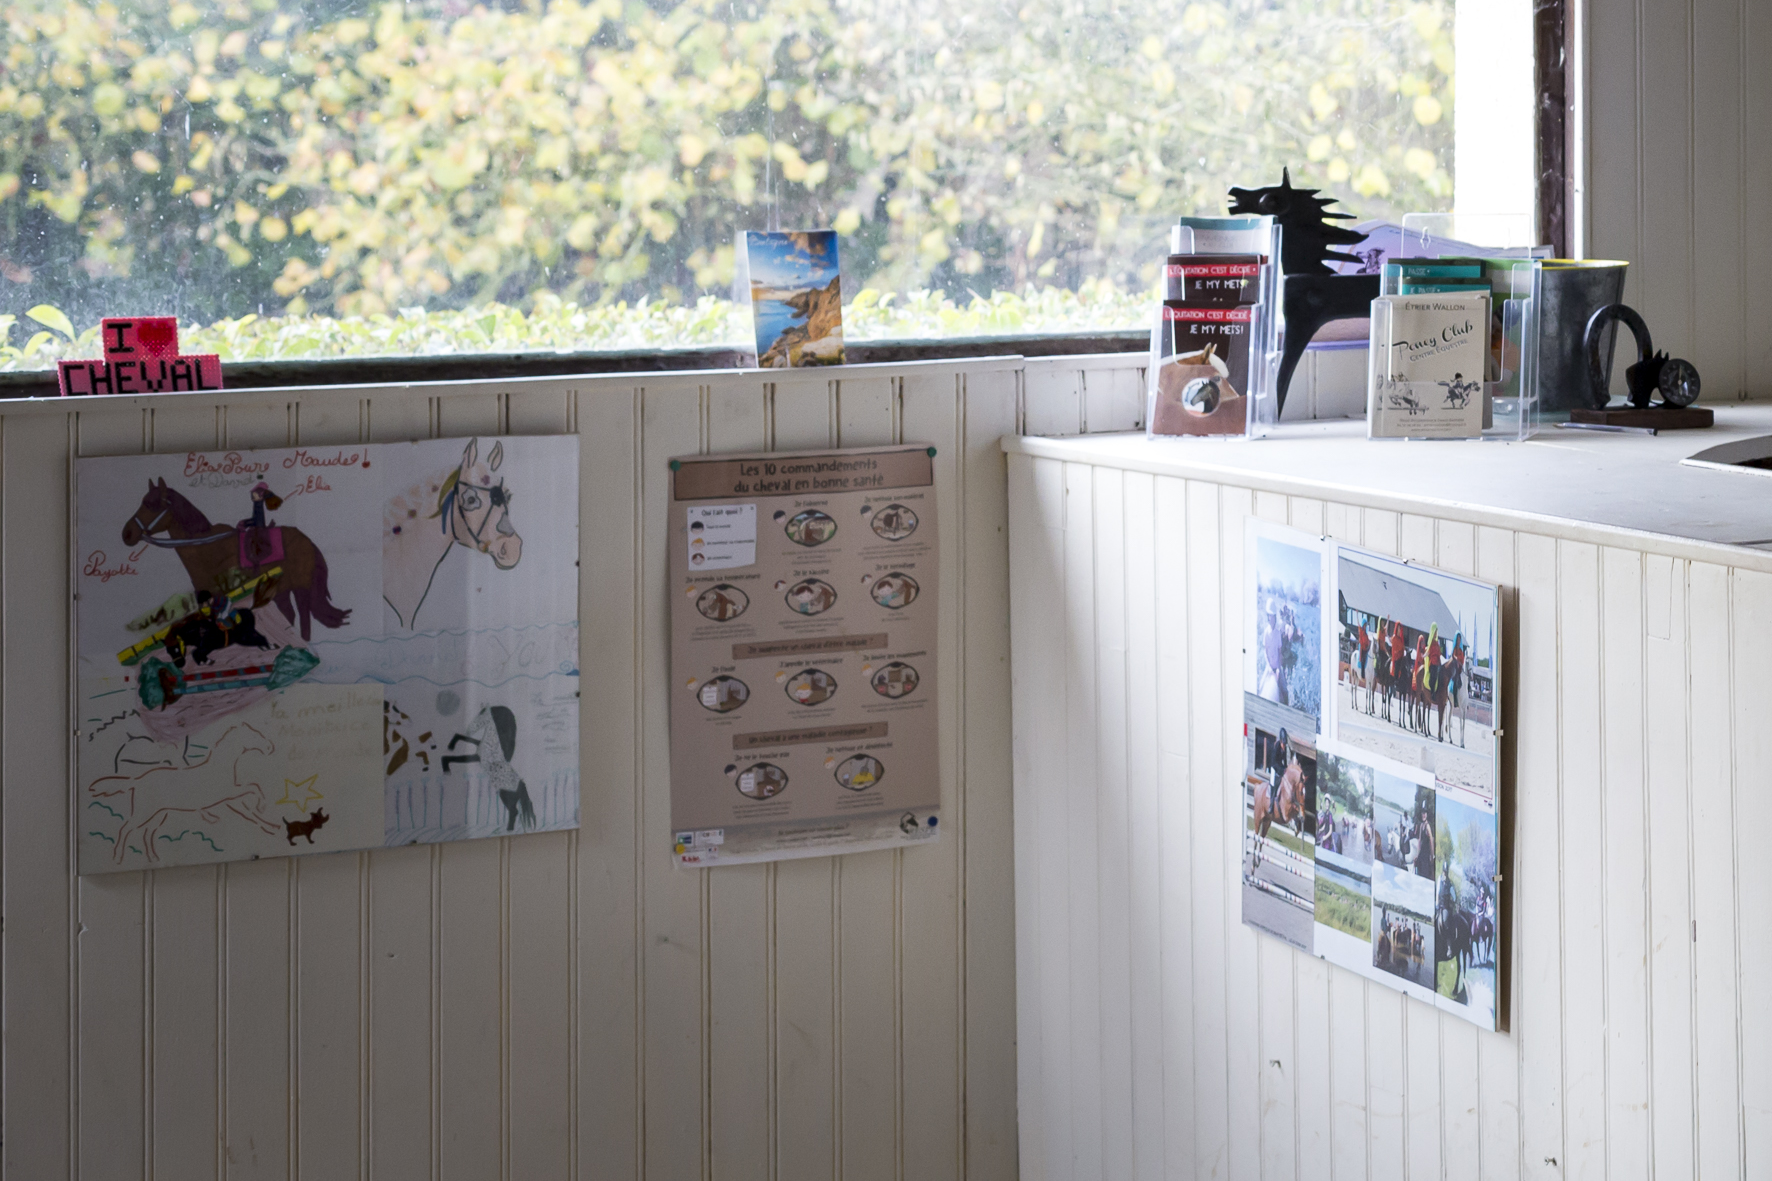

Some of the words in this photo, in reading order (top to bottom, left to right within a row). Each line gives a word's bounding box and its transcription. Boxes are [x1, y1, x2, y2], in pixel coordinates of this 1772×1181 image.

[1210, 266, 1227, 274] C'EST
[1408, 267, 1426, 275] PASSE
[1195, 279, 1203, 289] JE
[1405, 300, 1430, 311] ÉTRIER
[1432, 303, 1465, 311] WALLON
[1207, 311, 1224, 319] C'EST
[1226, 309, 1248, 319] DÉCIDÉ
[1189, 324, 1198, 334] JE
[1219, 325, 1244, 335] METS!
[107, 322, 135, 354] I
[1392, 337, 1438, 361] Poney
[1441, 320, 1473, 343] Club
[1409, 350, 1435, 362] CENTRE
[1435, 337, 1469, 355] ÉQUESTRE
[63, 358, 219, 395] CHEVAL
[740, 462, 760, 477] Les
[764, 462, 777, 476] 10
[780, 457, 878, 475] commandements
[734, 480, 750, 494] du
[753, 478, 791, 492] cheval
[795, 478, 810, 490] en
[812, 476, 849, 489] bonne
[853, 474, 884, 487] santé
[701, 508, 712, 517] Qui
